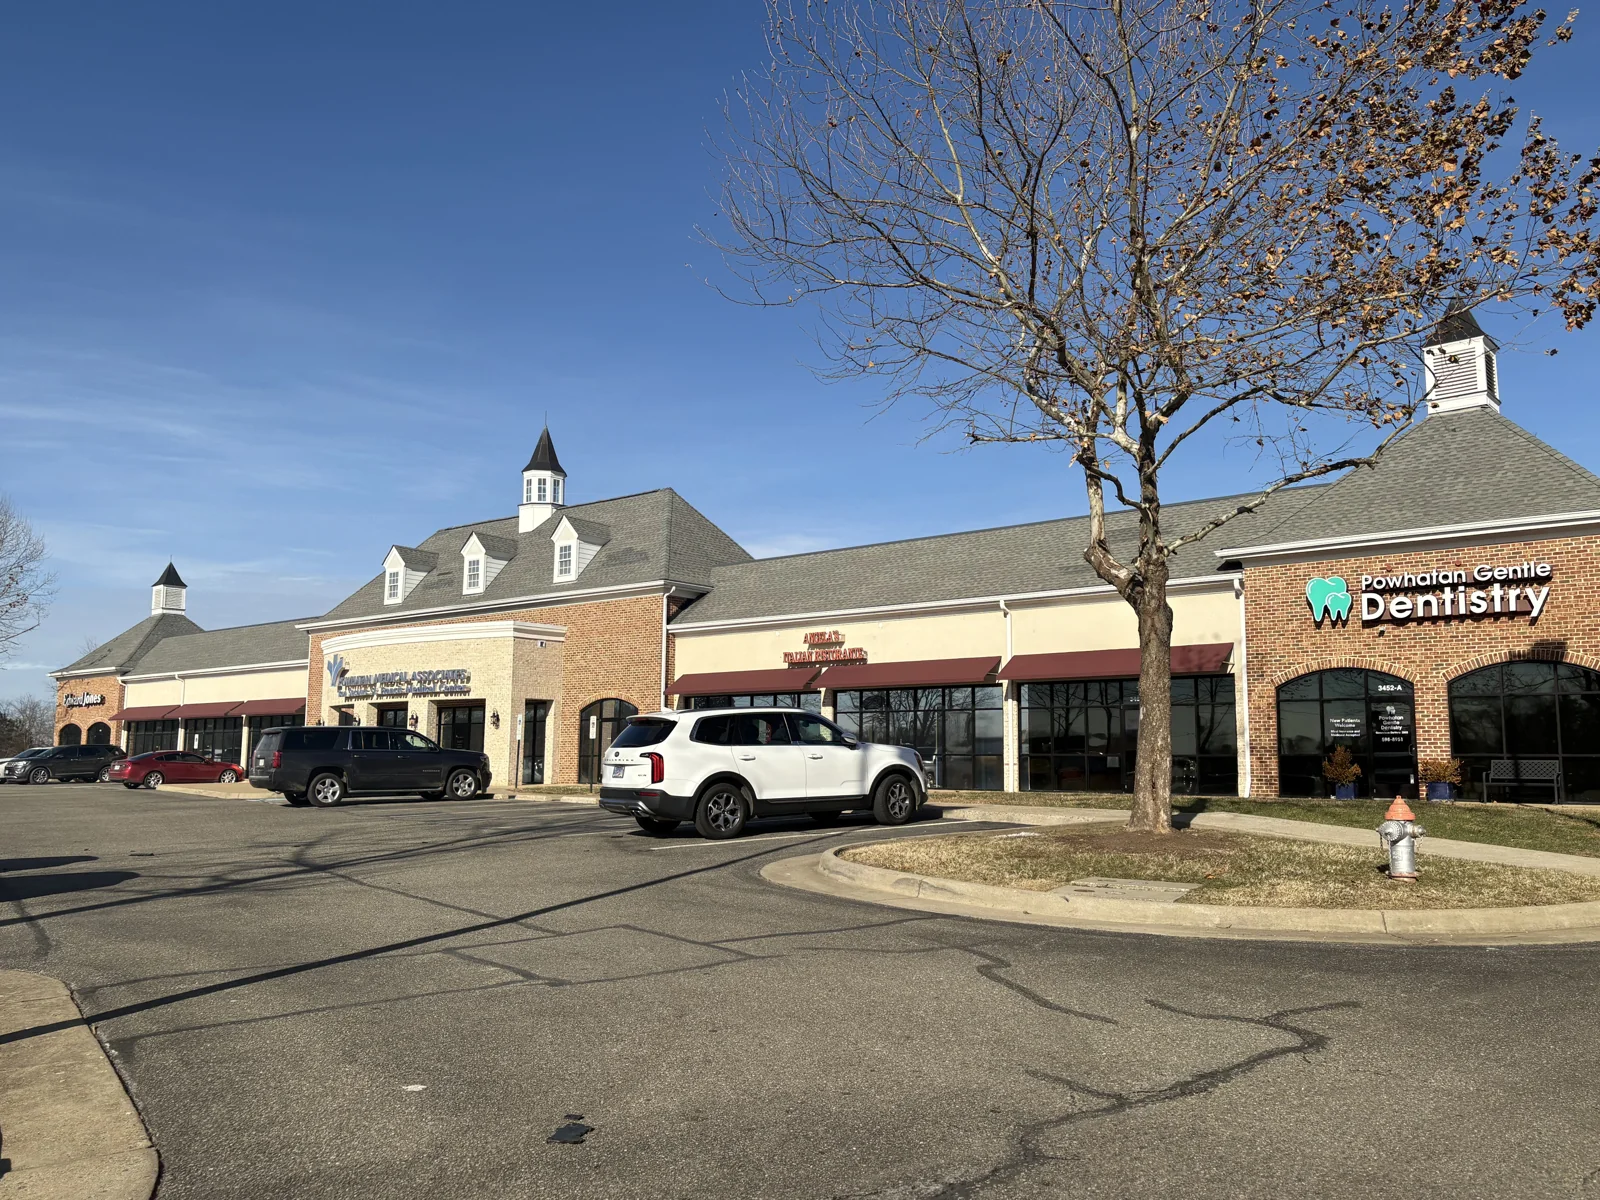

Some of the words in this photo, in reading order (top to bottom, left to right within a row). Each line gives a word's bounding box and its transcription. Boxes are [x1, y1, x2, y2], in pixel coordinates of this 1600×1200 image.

[1361, 568, 1466, 591] Powhatan
[1473, 561, 1551, 582] Gentle
[1362, 583, 1550, 621] Dentistry
[803, 630, 840, 644] ANGELA'S
[783, 650, 813, 663] ITALIAN
[374, 671, 408, 684] MEDICAL
[411, 669, 468, 682] ASSOCIATES
[1377, 684, 1403, 692] 3452-A
[82, 691, 101, 706] Jones
